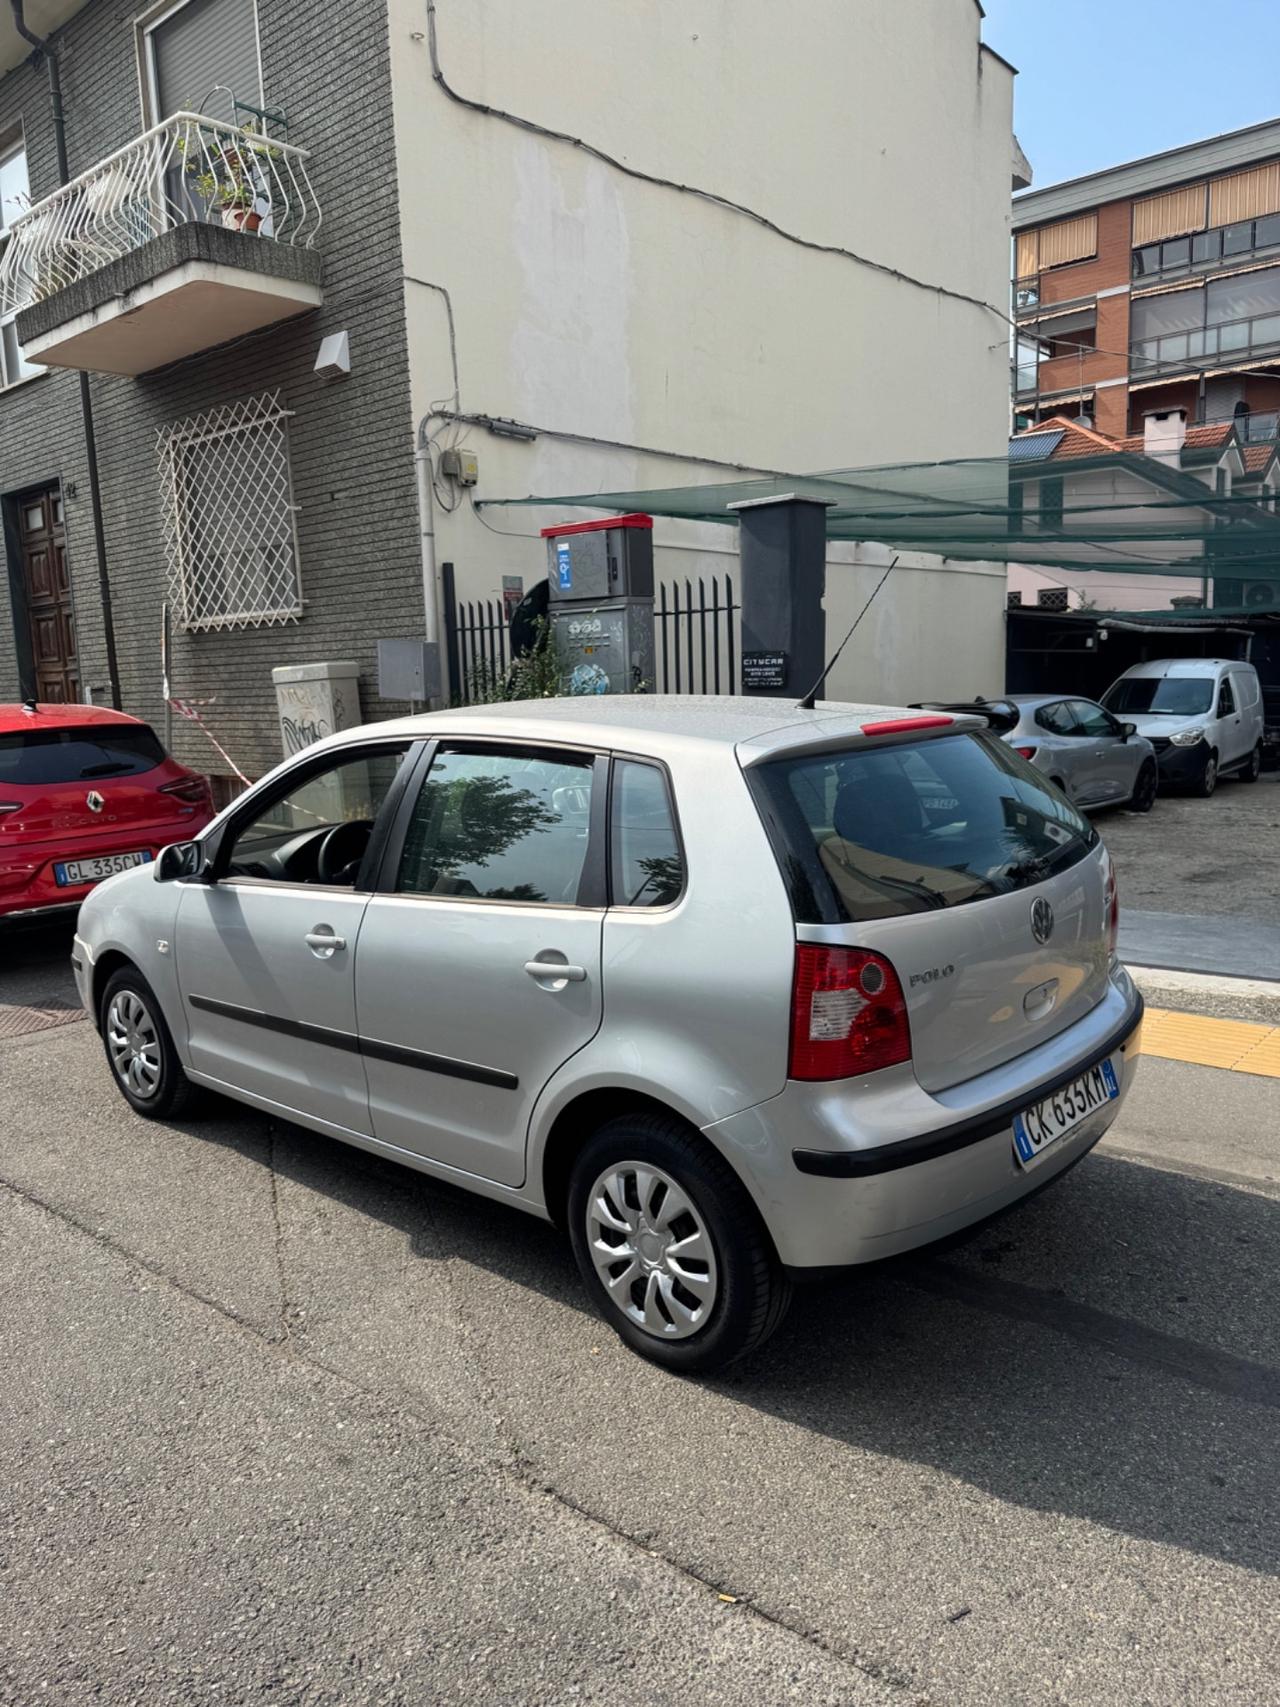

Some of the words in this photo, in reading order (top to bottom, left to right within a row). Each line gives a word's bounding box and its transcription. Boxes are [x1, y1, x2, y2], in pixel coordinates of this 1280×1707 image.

[67, 863, 88, 880] GL
[909, 964, 955, 988] POLO
[1025, 1101, 1054, 1146] CK
[1051, 1066, 1108, 1127] 635KM
